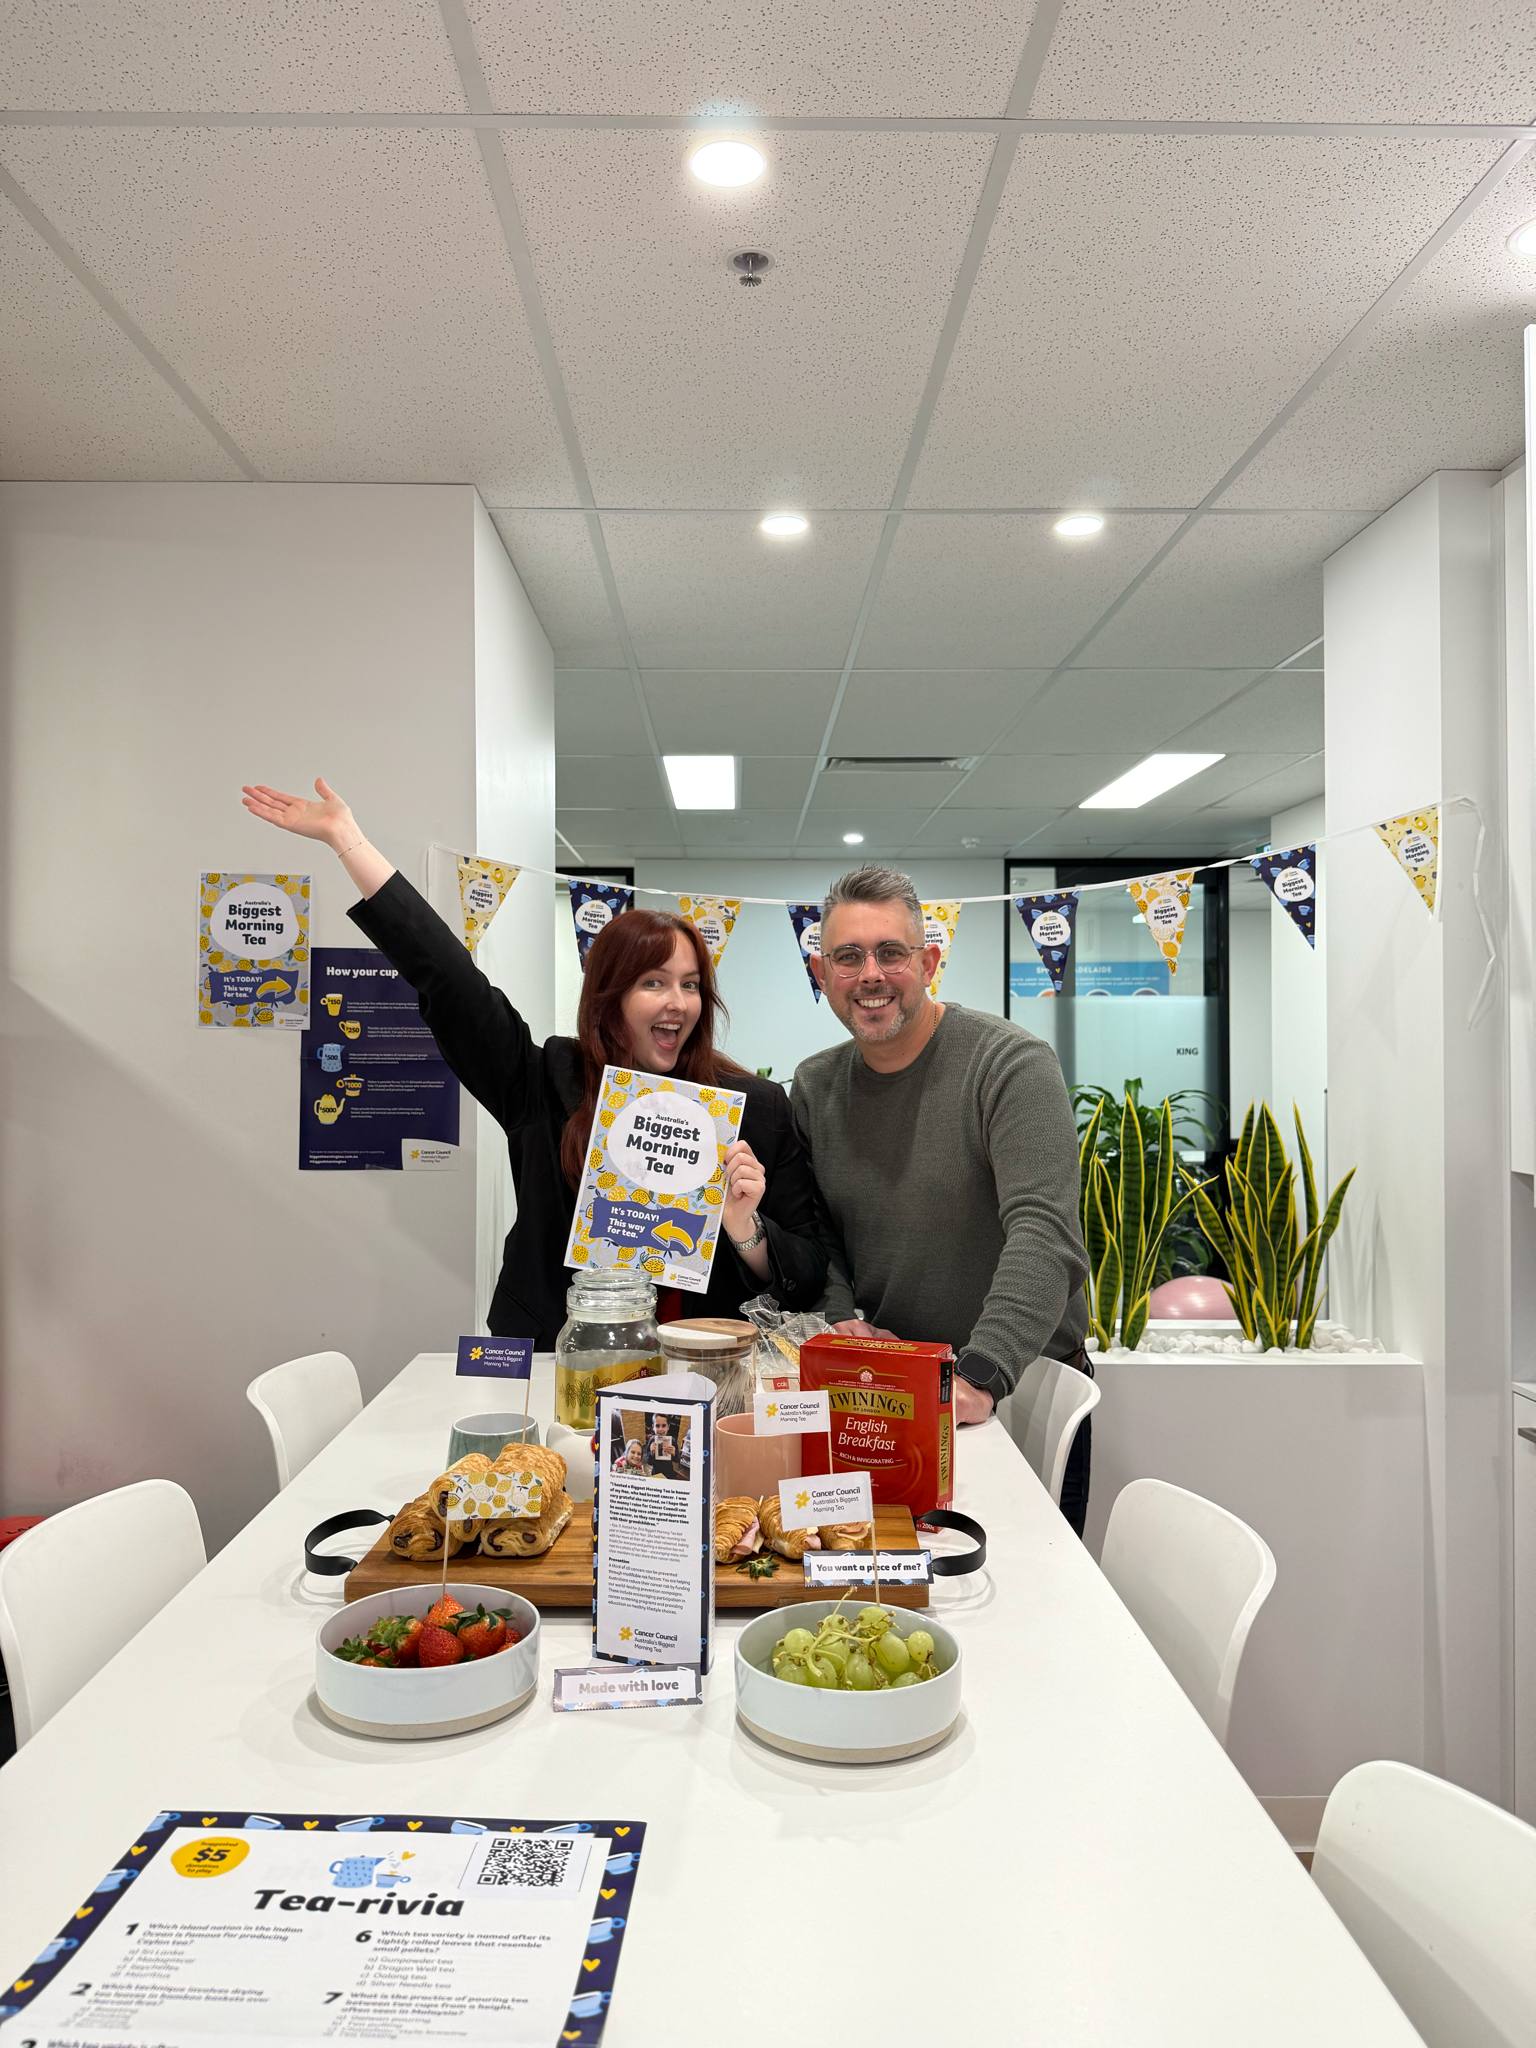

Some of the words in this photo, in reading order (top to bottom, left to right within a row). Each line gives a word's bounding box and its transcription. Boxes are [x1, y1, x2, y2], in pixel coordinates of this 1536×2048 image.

[1405, 843, 1426, 853] Biggest
[1406, 849, 1429, 860] Morning
[1282, 878, 1304, 888] Biggest
[1283, 884, 1307, 893] Morning
[470, 895, 492, 905] Morning
[472, 889, 492, 898] Biggest
[229, 904, 282, 918] Biggest
[1154, 906, 1176, 914] Biggest
[226, 920, 284, 934] Morning
[582, 916, 606, 925] Morning
[242, 934, 266, 944] Tea
[326, 966, 350, 976] How
[352, 968, 378, 978] your
[380, 969, 399, 979] cup
[1176, 1048, 1198, 1056] KING
[656, 1114, 689, 1125] Australia's
[634, 1116, 700, 1142] Biggest
[626, 1134, 700, 1164] Morning
[645, 1156, 674, 1175] Tea
[611, 1206, 625, 1216] It's
[627, 1208, 659, 1223] TODAY!
[609, 1218, 627, 1228] This
[628, 1222, 645, 1233] way
[607, 1226, 622, 1235] for
[622, 1230, 638, 1239] tea.
[830, 1392, 907, 1416] TWININGS
[846, 1417, 888, 1434] English
[838, 1432, 896, 1451] Breakfast
[940, 1425, 949, 1484] TWININGS
[812, 1490, 835, 1498] Cancer
[836, 1486, 860, 1496] Council
[812, 1497, 839, 1506] Australia's
[840, 1496, 859, 1504] Biggest
[635, 1629, 654, 1638] Cancer
[656, 1632, 677, 1641] Council
[635, 1644, 653, 1652] Morning
[579, 1682, 616, 1694] Made
[617, 1680, 648, 1693] with
[652, 1679, 679, 1690] love
[193, 1847, 231, 1862] $5
[254, 1889, 464, 1916] Tea-rivia
[125, 1923, 139, 1936] 1
[239, 1933, 289, 1942] producing
[355, 1930, 372, 1943] 6
[70, 1983, 92, 1996] 2
[323, 1992, 344, 2005] 7
